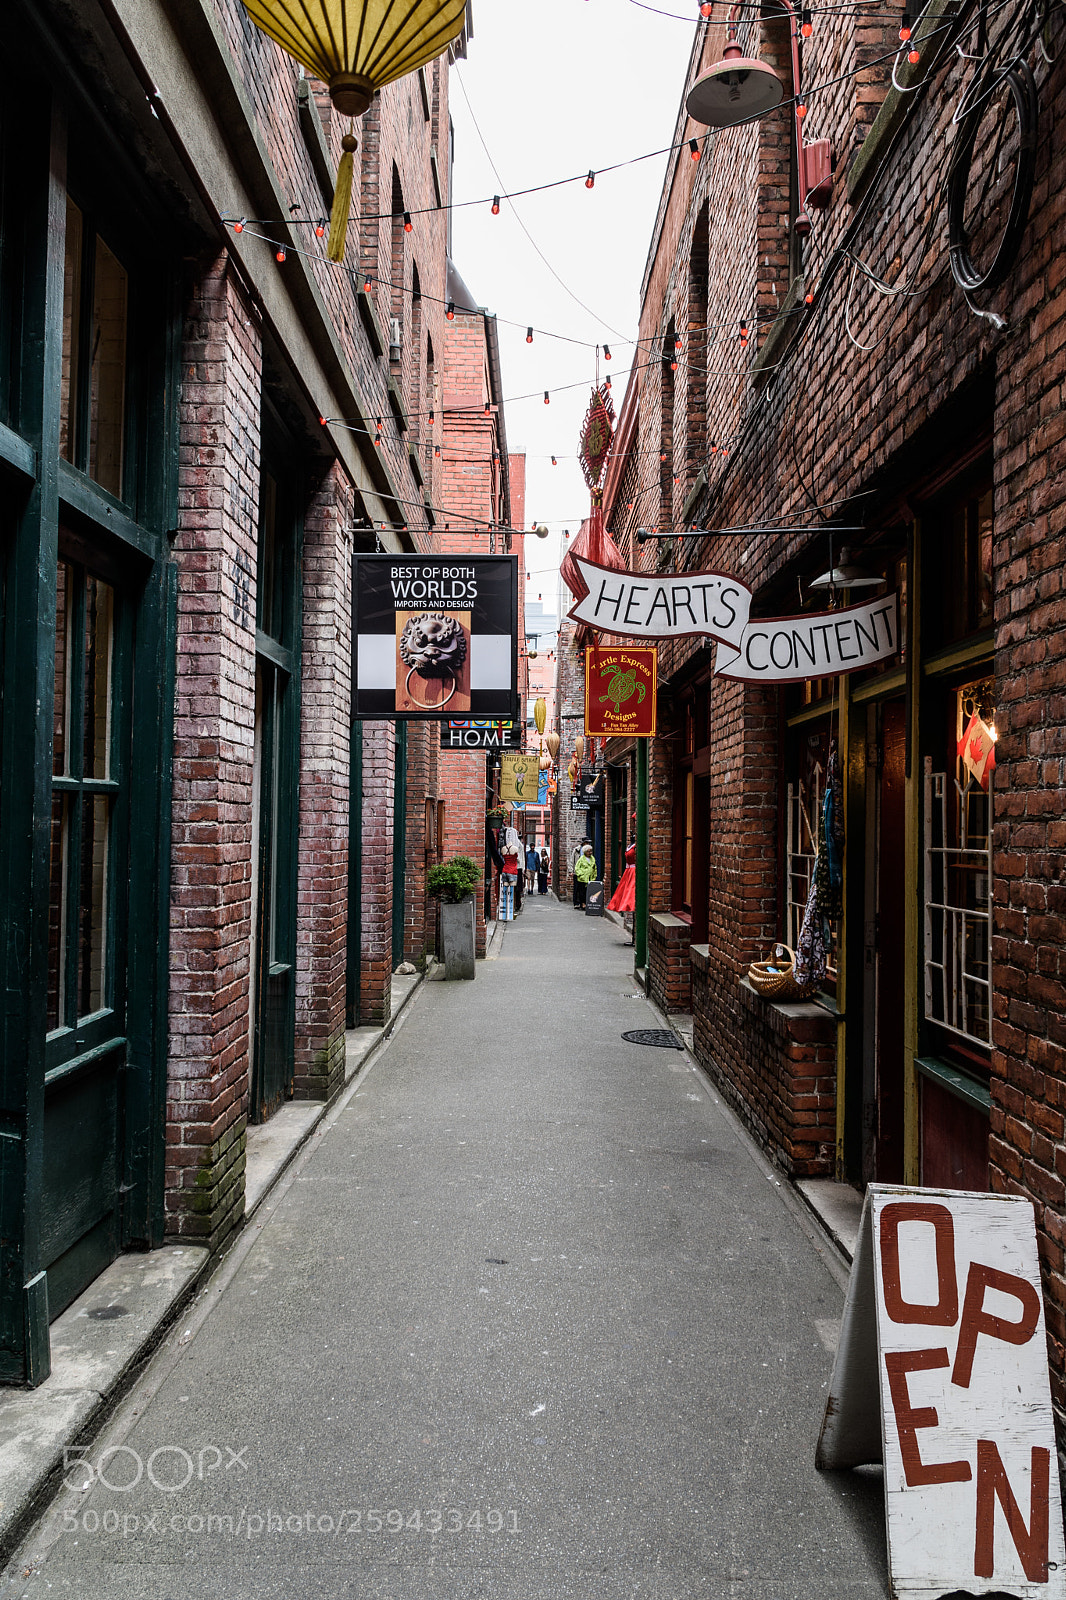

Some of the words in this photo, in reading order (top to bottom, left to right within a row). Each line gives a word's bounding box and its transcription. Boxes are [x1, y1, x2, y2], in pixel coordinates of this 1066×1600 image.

[391, 567, 420, 579] BEST
[422, 567, 440, 579] OF
[442, 567, 475, 579] BOTH
[390, 580, 478, 599] WORLDS
[394, 600, 427, 608] IMPORTS
[428, 600, 445, 608] AND
[446, 600, 475, 608] DESIGN
[593, 578, 740, 629] HEART'S
[745, 604, 894, 671] CONTENT
[620, 654, 652, 677] Express
[604, 709, 637, 722] Designs
[450, 729, 512, 747] HOME
